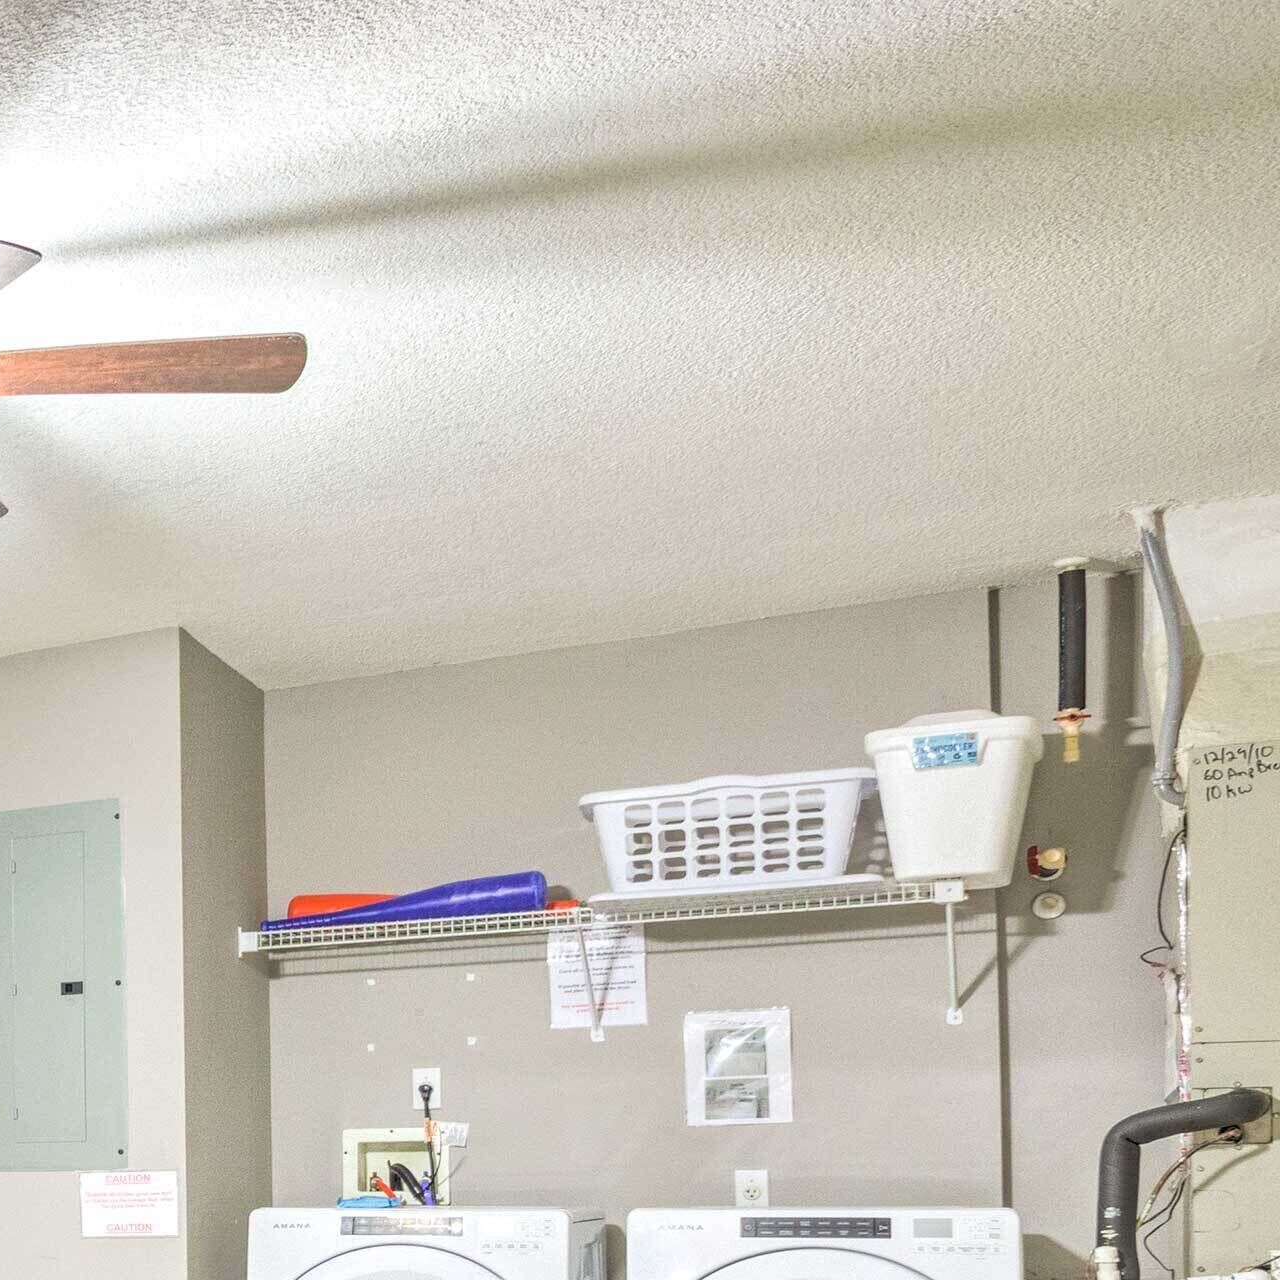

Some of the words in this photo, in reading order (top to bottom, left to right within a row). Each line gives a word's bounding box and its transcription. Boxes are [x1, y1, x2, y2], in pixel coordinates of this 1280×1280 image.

[1204, 744, 1273, 765] 12/29/10
[1204, 769, 1223, 780] 60
[1206, 785, 1221, 801] 10
[105, 1173, 151, 1184] CAUTION
[106, 1223, 153, 1232] CAUTION
